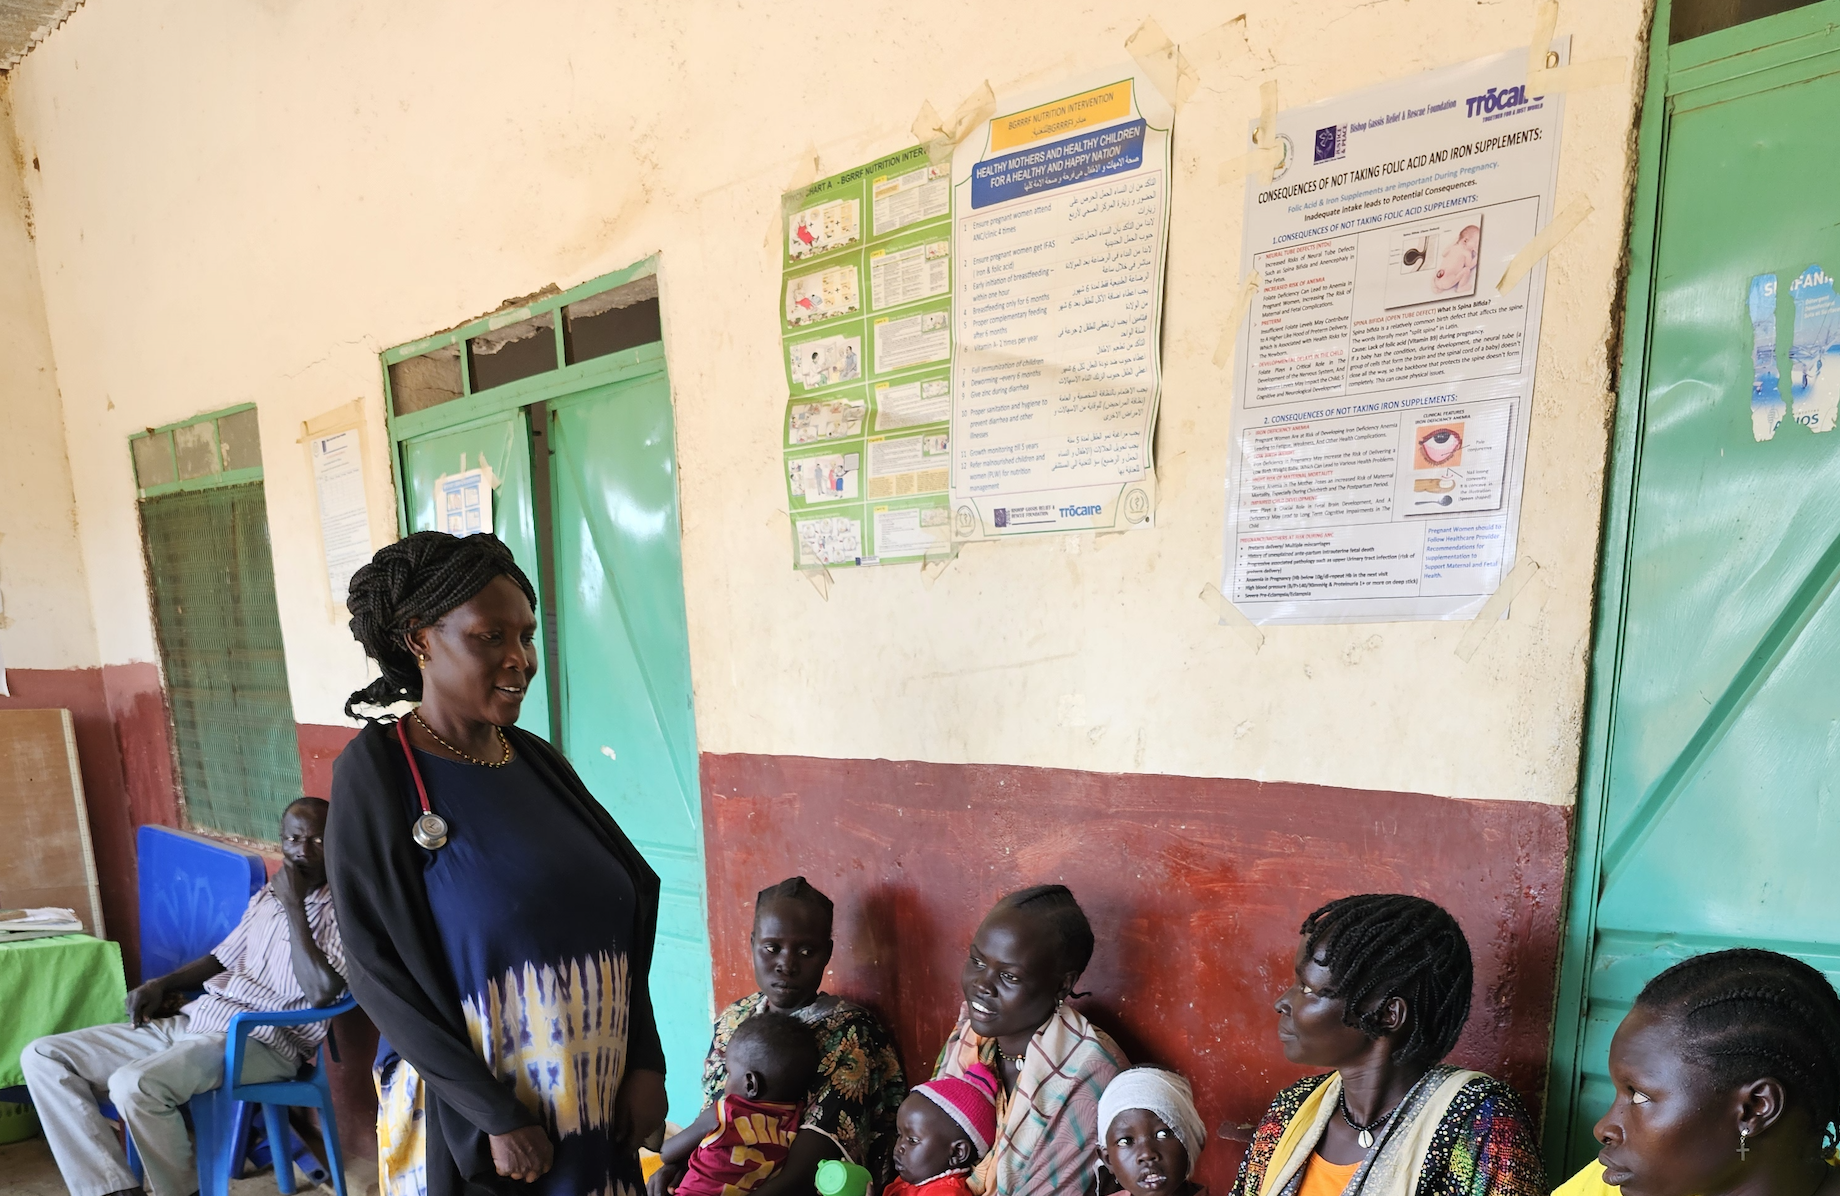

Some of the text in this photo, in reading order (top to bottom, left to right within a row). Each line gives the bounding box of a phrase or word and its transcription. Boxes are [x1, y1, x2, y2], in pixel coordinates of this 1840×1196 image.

[1008, 116, 1031, 130] BGRRRF
[1033, 106, 1066, 123] NUTRITION
[1067, 92, 1114, 112] INTERVENTION
[1350, 122, 1367, 134] Bishop
[1368, 117, 1385, 129] Gassis
[1385, 112, 1401, 124] Relief
[1407, 108, 1426, 119] Rescue
[1427, 99, 1457, 114] Foundation
[1466, 85, 1544, 118] Trōcai
[976, 160, 1008, 179] HEALTHY
[1008, 151, 1045, 170] MOTHERS
[1046, 147, 1062, 161] AND
[1063, 136, 1099, 156] HEALTHY
[1099, 125, 1141, 146] CHILDREN
[990, 145, 1121, 188] FOR A HEALTHY AND HAPPY NATION
[1258, 127, 1542, 204] CONSEQUENCES OF NOT TAKING FOLIC ACID AND IRON SUPPLEMENTS:
[827, 180, 834, 190] A
[840, 171, 863, 186] BGRRF
[864, 157, 902, 177] NUTRITION
[1288, 204, 1303, 213] Folic
[1303, 200, 1318, 210] Acid
[1318, 199, 1324, 207] &
[1326, 197, 1339, 205] Iron
[1340, 187, 1384, 202] Supplements
[1384, 184, 1397, 192] are
[1434, 170, 1458, 181] During
[1459, 161, 1499, 175] Pregnancy.
[1272, 194, 1478, 245] 1.CONSEQUENCES OF NOT TAKING FOLIC ACID SUPPLEMENTS:
[1304, 209, 1341, 221] Inadequate
[1364, 198, 1382, 209] leads
[1392, 189, 1424, 203] Potential
[1425, 179, 1477, 196] Consequences.
[1264, 393, 1458, 425] 2. CONSEQUENCES OF NOT TAKING IRON SUPPLEMENTS:
[1059, 505, 1102, 518] Trōcaire
